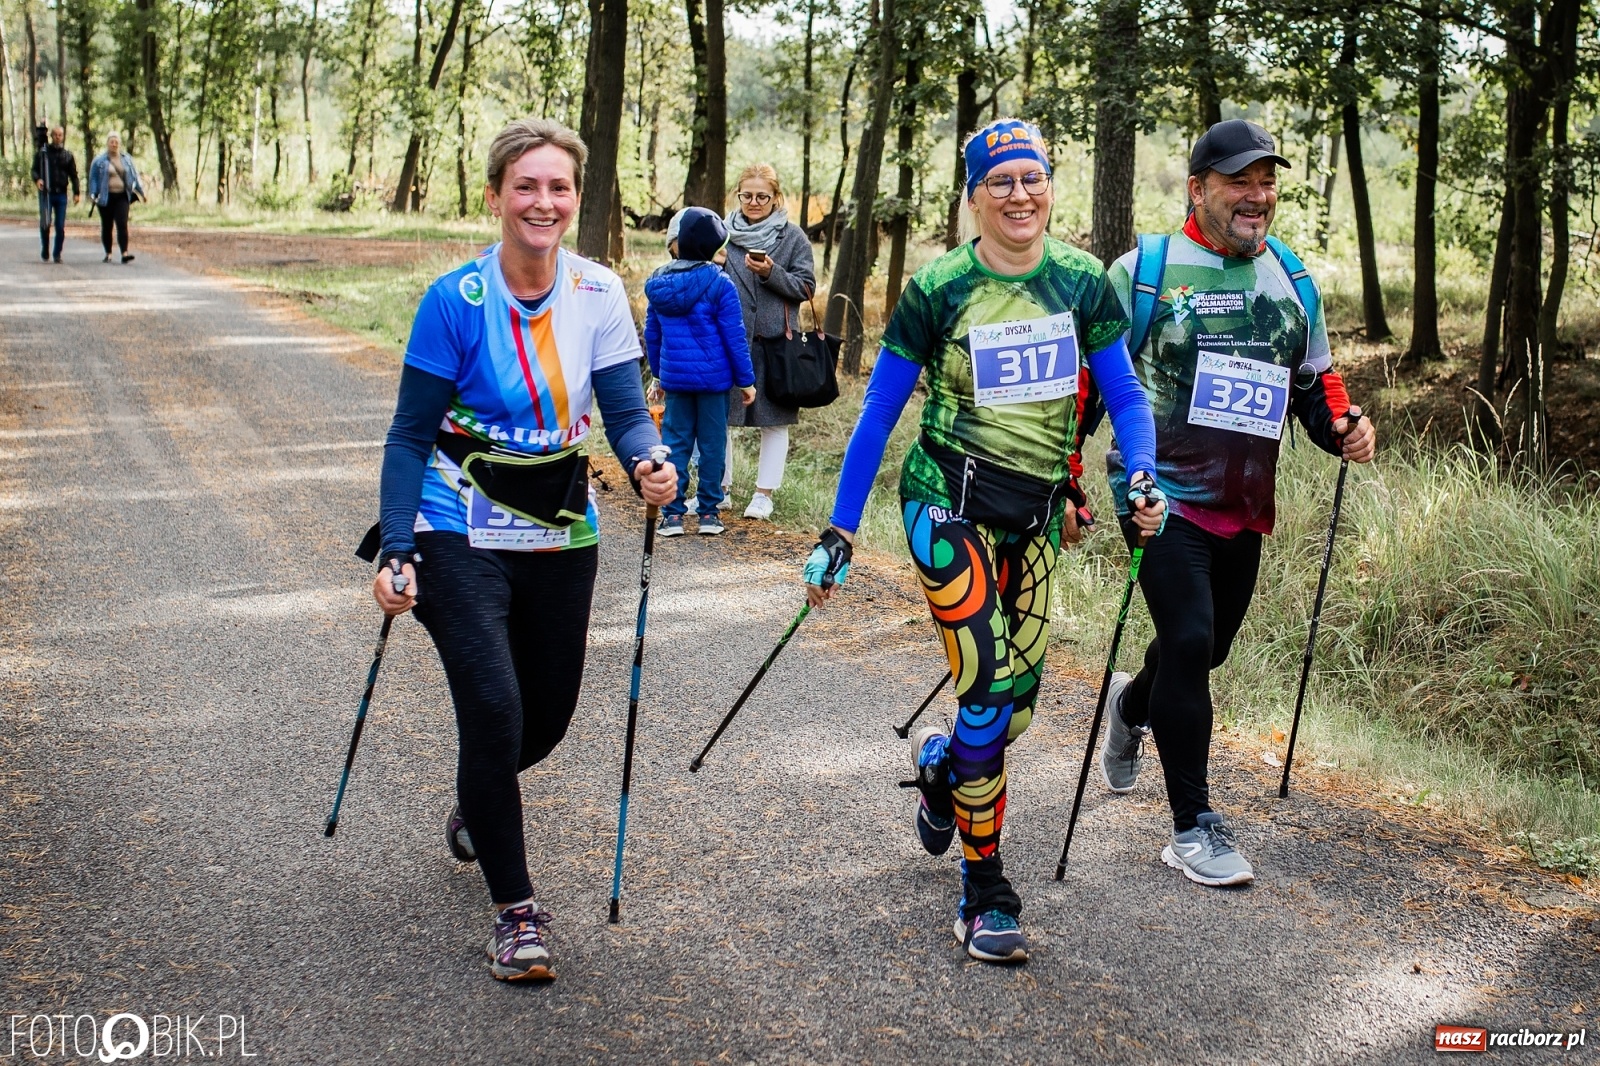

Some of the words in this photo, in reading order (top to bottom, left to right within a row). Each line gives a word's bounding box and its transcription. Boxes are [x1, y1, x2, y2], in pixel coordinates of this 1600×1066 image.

[1196, 300, 1244, 308] PÓŁMARATON
[1196, 307, 1231, 315] RAFAMET
[1005, 324, 1032, 335] DYSZKA
[997, 343, 1058, 384] 317
[1228, 360, 1252, 371] DYSZKA
[1208, 378, 1273, 417] 329
